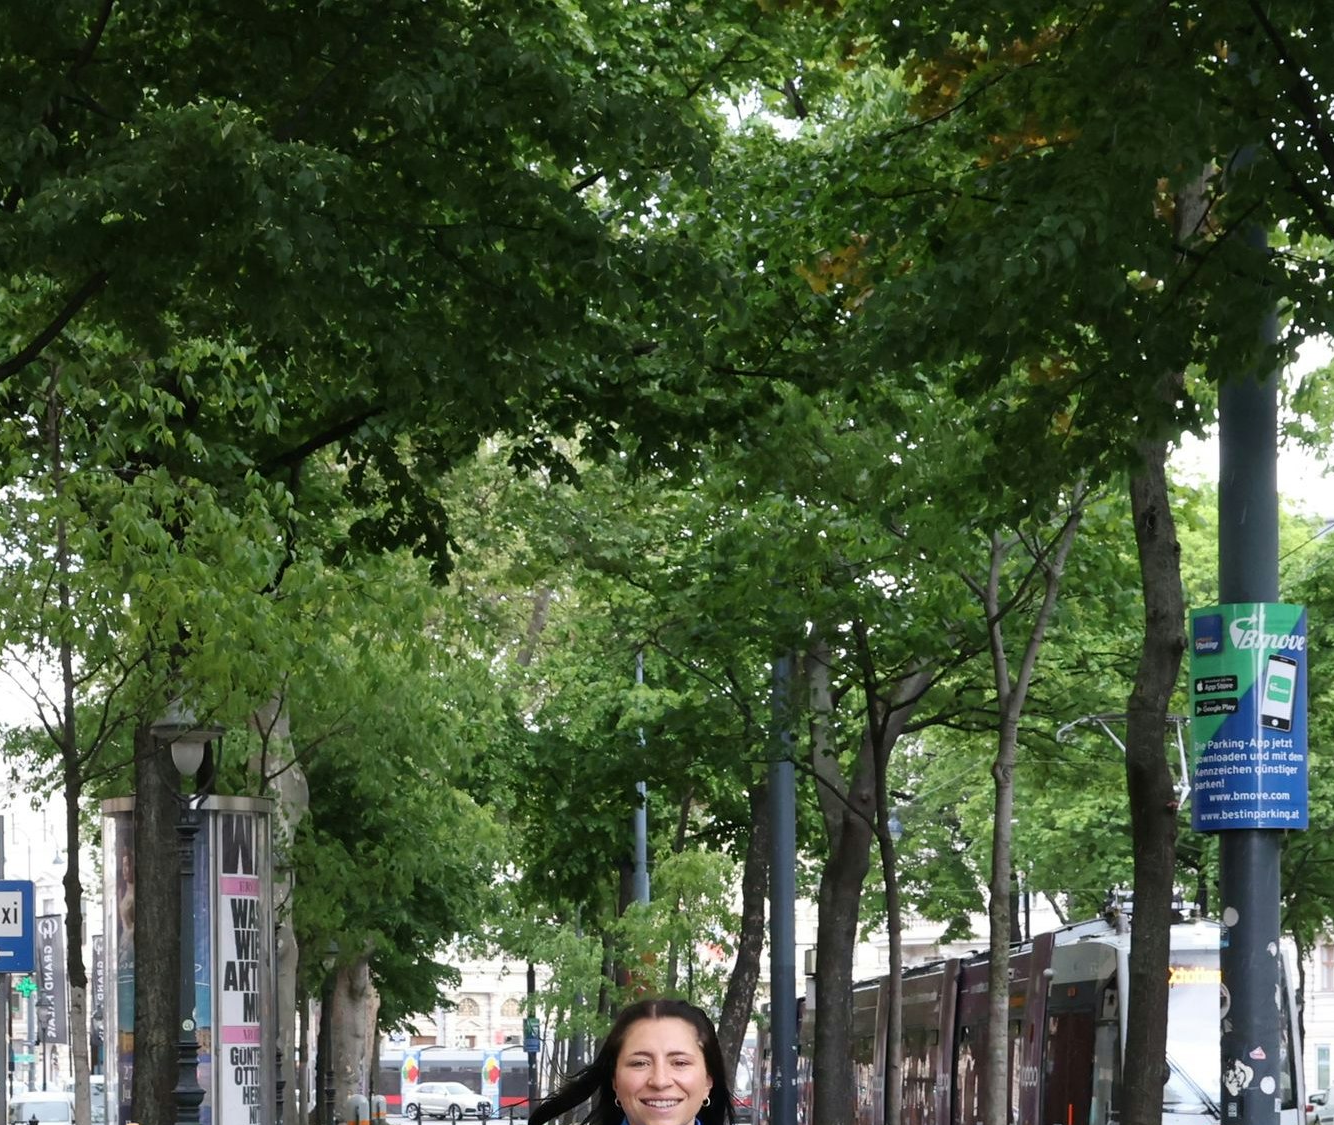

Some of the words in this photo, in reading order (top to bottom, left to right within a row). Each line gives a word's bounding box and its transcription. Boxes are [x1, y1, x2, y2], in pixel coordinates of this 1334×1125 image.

[1208, 739, 1270, 750] Parking-App
[1272, 738, 1293, 749] jetzt
[1195, 753, 1247, 764] downloaden
[1250, 752, 1269, 761] und
[1272, 752, 1286, 761] mit
[1289, 752, 1303, 761] dem
[1195, 766, 1252, 777] Kennzeichen
[1255, 764, 1298, 776] günstiger
[1195, 779, 1225, 791] parken!
[1209, 791, 1290, 801] www.bmove.com
[1201, 809, 1299, 821] www.bestinparking.at
[222, 814, 259, 876] W
